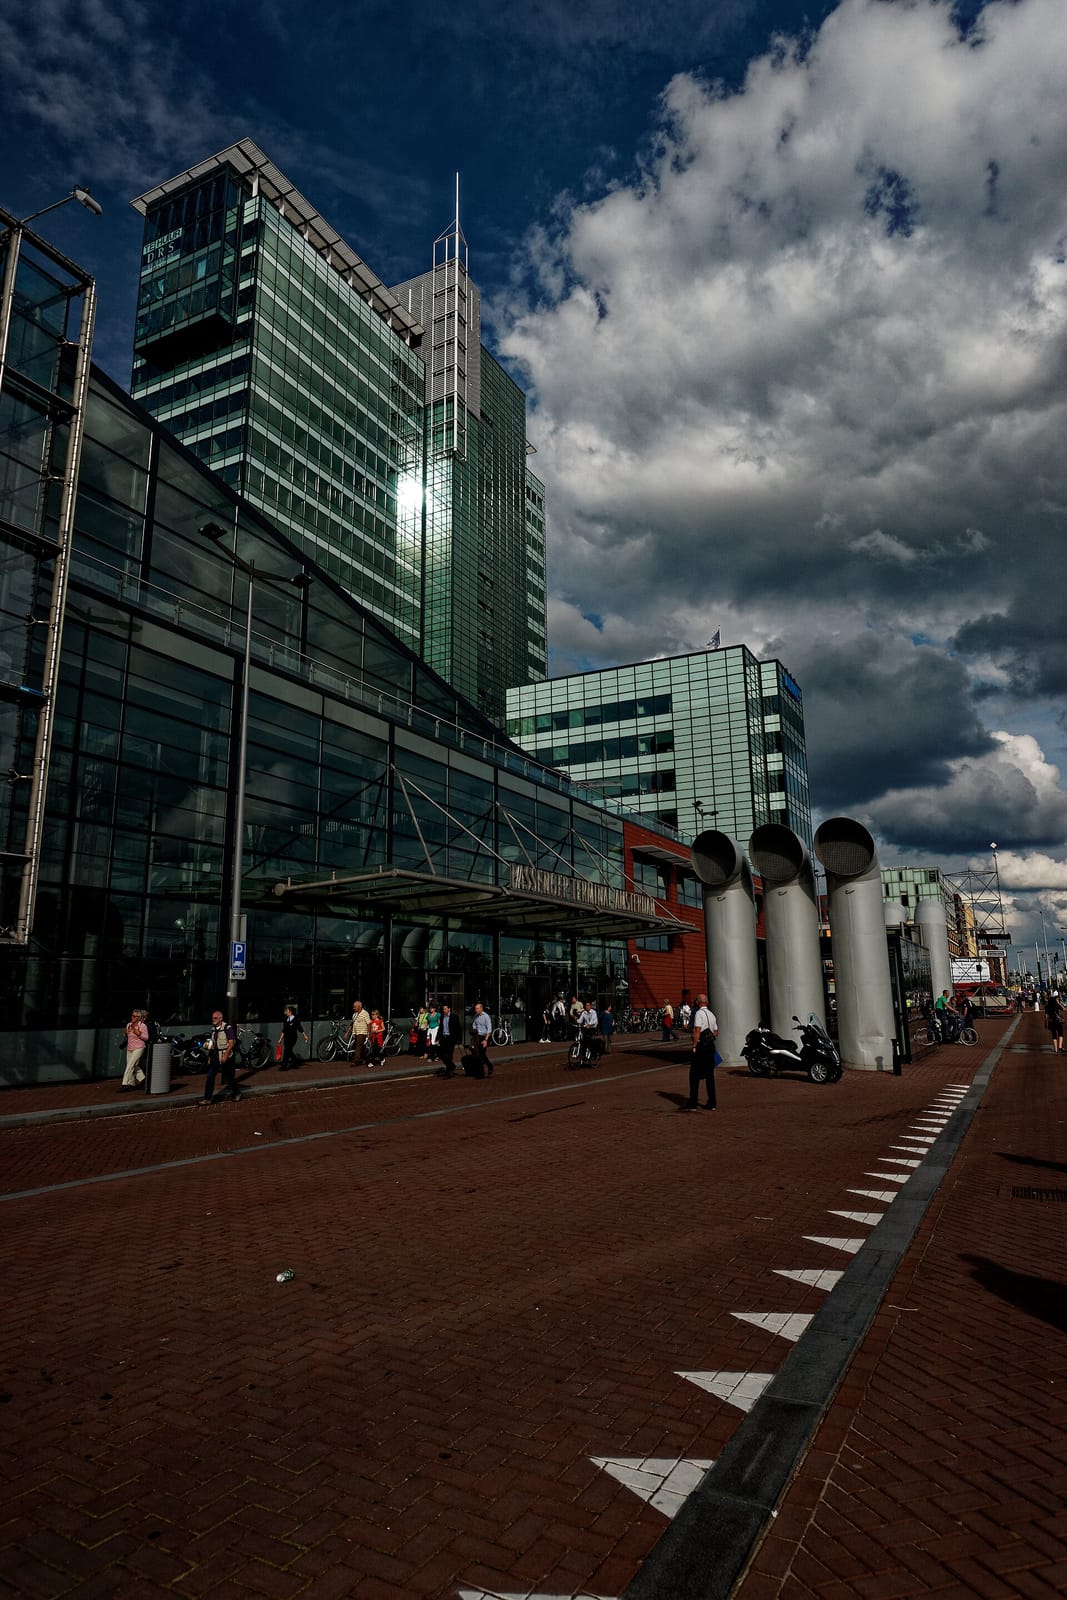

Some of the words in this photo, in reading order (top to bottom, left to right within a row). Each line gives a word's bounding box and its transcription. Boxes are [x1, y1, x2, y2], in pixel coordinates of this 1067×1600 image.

[147, 241, 175, 263] DRS
[511, 863, 568, 899] PASSENGER
[569, 877, 611, 908] TERMINAL
[613, 889, 656, 917] AMSTERDAM
[235, 944, 243, 959] P
